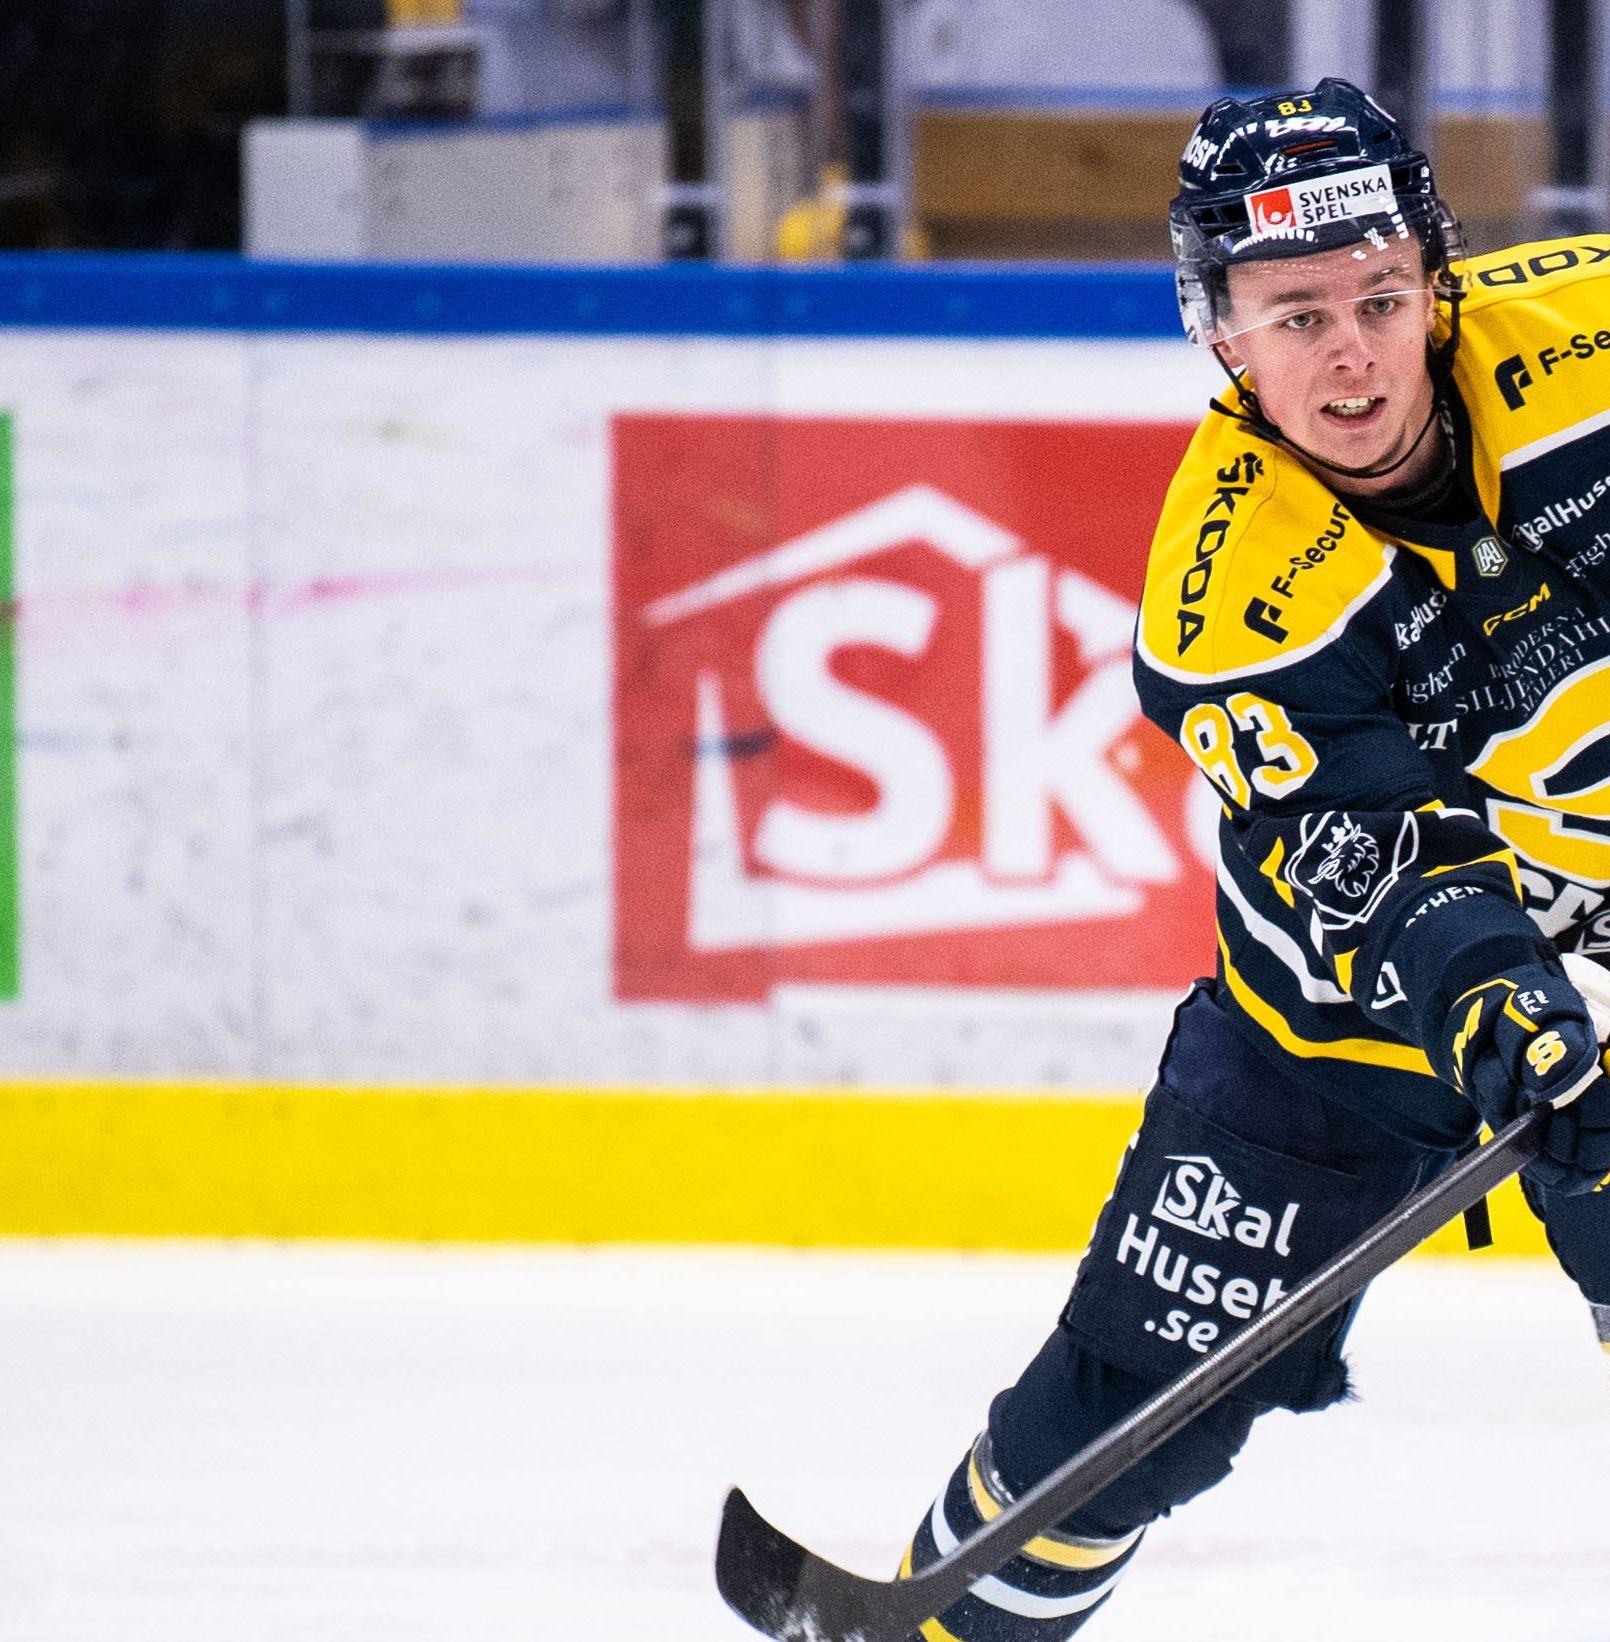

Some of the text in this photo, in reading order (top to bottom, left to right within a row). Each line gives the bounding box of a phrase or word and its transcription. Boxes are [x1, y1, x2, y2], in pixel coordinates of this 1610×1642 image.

[1299, 175, 1389, 208] SVENSKA
[1302, 204, 1353, 226] SPEL
[1270, 500, 1352, 599] F-Secur
[1483, 581, 1551, 637] CCM
[1179, 691, 1320, 811] 83
[1163, 1163, 1301, 1258] Skal
[1144, 1309, 1220, 1354] .se
